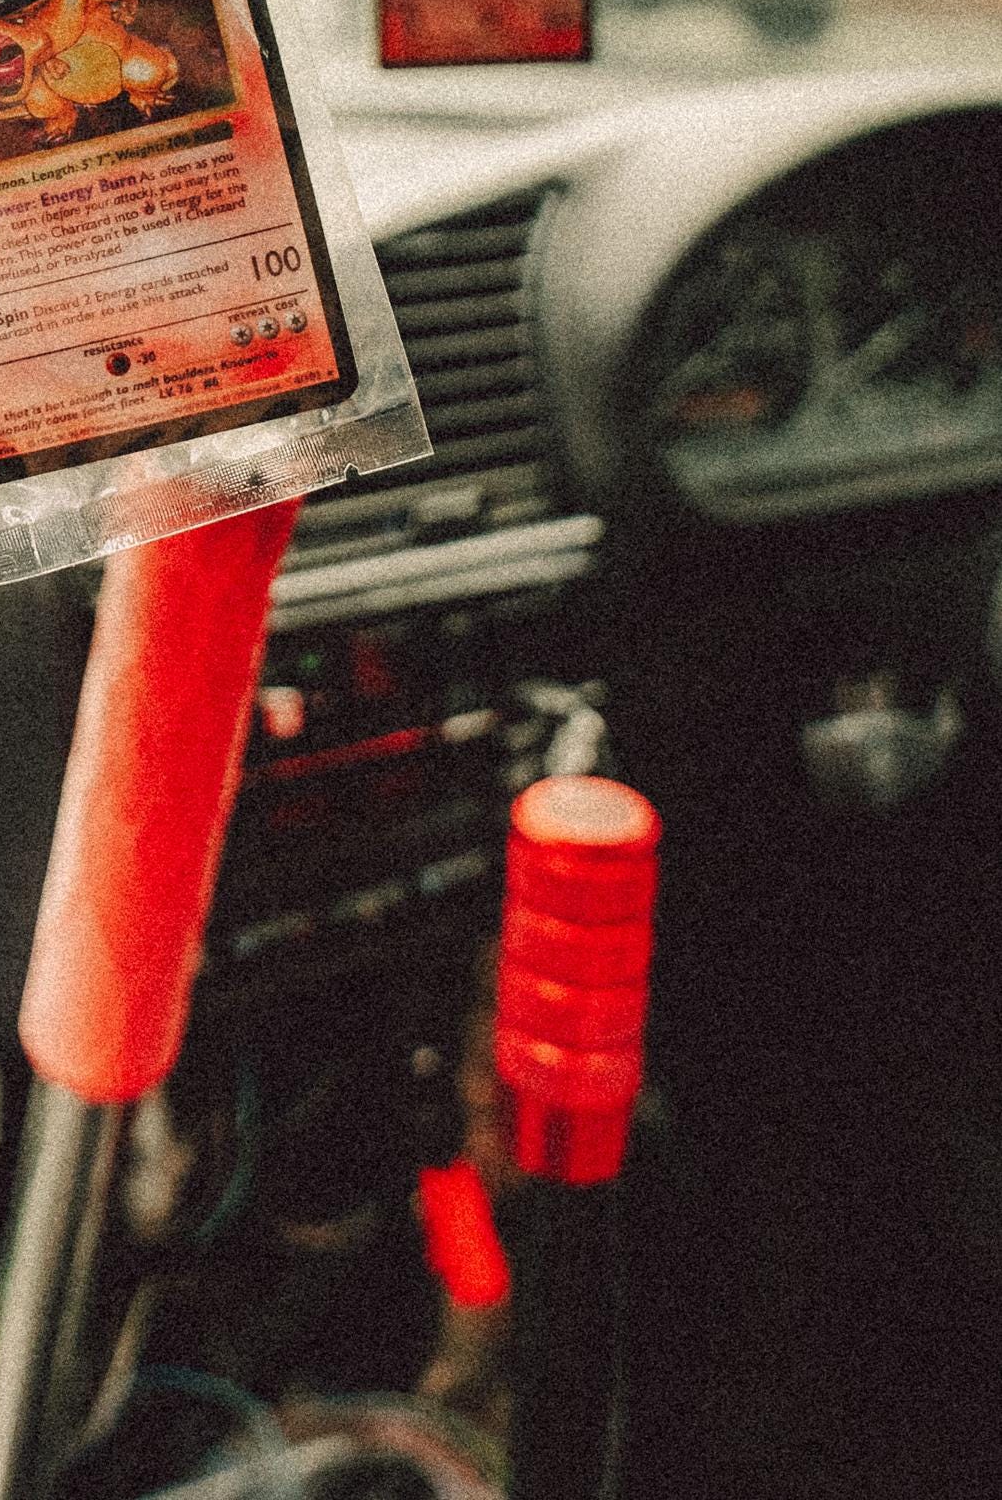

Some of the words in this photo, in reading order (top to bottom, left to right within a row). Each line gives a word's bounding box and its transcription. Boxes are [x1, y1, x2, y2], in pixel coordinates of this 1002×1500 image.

[10, 216, 36, 228] turn
[85, 200, 110, 214] your
[159, 182, 181, 195] you
[185, 174, 209, 188] may
[213, 166, 240, 179] turn
[40, 182, 94, 210] Energy
[99, 173, 136, 191] Burn
[138, 170, 155, 182] As
[158, 161, 191, 178] often
[194, 159, 207, 168] as
[211, 152, 235, 166] you
[19, 246, 43, 261] This
[47, 237, 87, 255] power
[90, 228, 119, 243] can't
[123, 224, 138, 235] be
[141, 216, 170, 230] used
[185, 197, 246, 221] Charizard
[33, 230, 47, 241] to
[50, 214, 110, 238] Charizard
[114, 209, 139, 222] into
[160, 193, 202, 215] Energy
[205, 187, 223, 198] for
[227, 181, 248, 193] the
[46, 259, 59, 269] or
[250, 245, 303, 280] 100
[32, 296, 80, 317] Discard
[95, 283, 137, 305] Energy
[140, 275, 173, 291] cards
[176, 262, 230, 283] attached
[46, 318, 58, 329] in
[61, 309, 96, 325] order
[101, 305, 115, 316] to
[118, 301, 139, 312] use
[142, 293, 164, 306] this
[227, 306, 269, 322] retreat
[274, 298, 299, 311] cost
[82, 333, 143, 358] resistance
[3, 407, 30, 422] that
[44, 398, 65, 411] hot
[68, 388, 113, 408] enough
[115, 383, 128, 394] to
[132, 377, 160, 391] melt
[45, 410, 78, 426] cause
[81, 400, 117, 417] forest
[177, 383, 193, 394] 76
